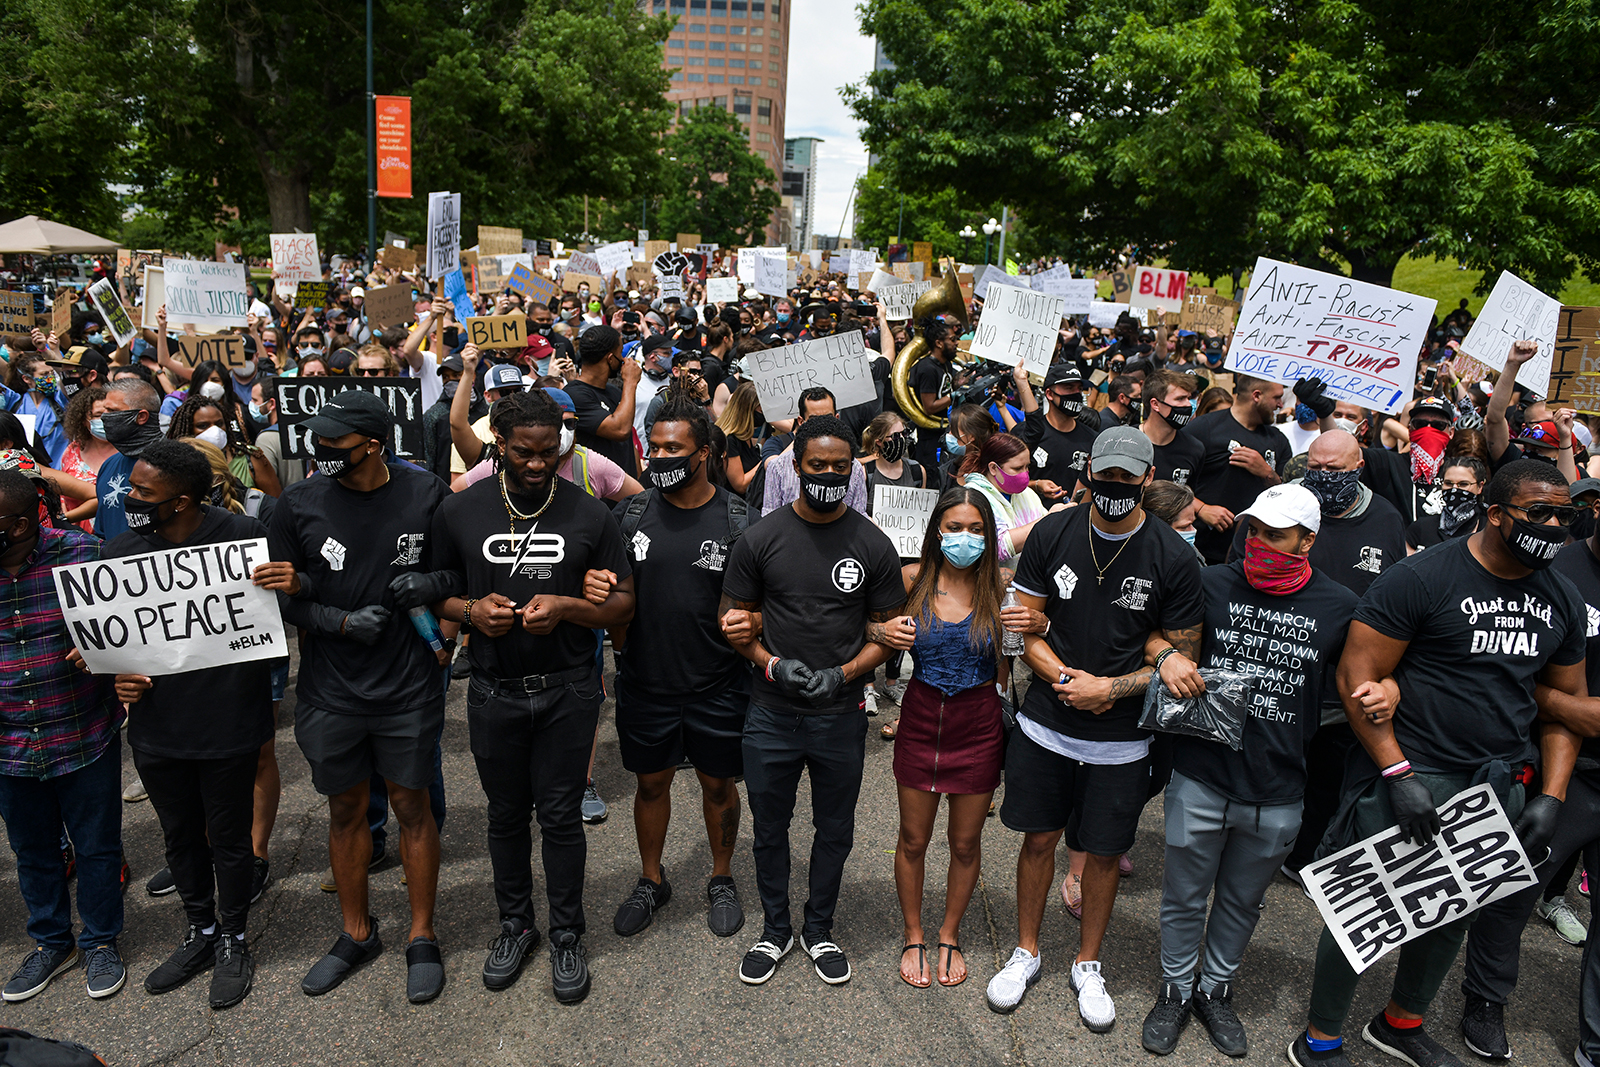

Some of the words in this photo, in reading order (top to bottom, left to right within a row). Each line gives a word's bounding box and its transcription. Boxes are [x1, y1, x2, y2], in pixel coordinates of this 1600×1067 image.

[274, 238, 314, 254] BLACK
[275, 252, 312, 266] LIVES
[186, 276, 198, 286] for
[277, 270, 316, 280] WHITE
[508, 276, 525, 291] NO
[514, 266, 530, 280] NO
[1139, 270, 1186, 300] BLM
[0, 306, 27, 316] ENCE
[166, 286, 204, 314] SOCIAL
[205, 290, 248, 316] JUSTICE
[985, 286, 1002, 310] NO
[1008, 290, 1064, 332] JUSTICE
[1188, 304, 1224, 316] BLACK
[1500, 284, 1558, 342] BLAC
[472, 320, 518, 346] BLM
[974, 323, 997, 348] NO
[1008, 329, 1050, 366] PEACE
[180, 338, 244, 367] VOTE
[756, 342, 818, 372] BLACK
[824, 332, 866, 360] LIVES
[1235, 352, 1278, 373] VOTE
[1466, 321, 1550, 394] MATE
[756, 368, 823, 398] MATTER
[832, 354, 866, 384] ACT
[278, 384, 419, 420] EQUITY
[288, 424, 316, 456] FO
[650, 471, 660, 488] N'T
[660, 468, 686, 488] BREATHE
[1108, 497, 1136, 516] BREATHE
[875, 512, 916, 531] SHOULD
[1516, 532, 1522, 544] I
[1520, 535, 1547, 558] CAN'T
[59, 564, 118, 608] NO
[122, 542, 258, 597] JUSTICE
[520, 564, 552, 580] 45
[1135, 578, 1152, 588] JUSTICE
[72, 614, 129, 650] NO
[134, 592, 254, 646] PEACE
[1229, 602, 1254, 617] WE
[1258, 608, 1318, 632] MARCH,
[1460, 596, 1504, 625] Just
[1507, 600, 1520, 612] a
[1522, 592, 1554, 629] Kid
[1494, 616, 1524, 628] FROM
[228, 632, 274, 651] #BLM
[1230, 614, 1269, 634] Y'ALL
[1272, 624, 1311, 643] MAD.
[1216, 628, 1240, 644] WE
[1242, 634, 1266, 648] SIT
[1268, 640, 1318, 662] DOWN,
[1224, 642, 1262, 662] Y'ALL
[1266, 652, 1302, 670] MAD.
[1470, 630, 1540, 657] DUVAL
[1210, 654, 1234, 670] WE
[1236, 660, 1286, 682] SPEAK
[1260, 679, 1296, 697] MAD.
[1247, 704, 1296, 724] SILENT.
[1253, 694, 1280, 710] DIE,
[1437, 790, 1532, 904] BLACK
[1373, 832, 1468, 930] LIVES
[1312, 848, 1407, 964] MATTER
